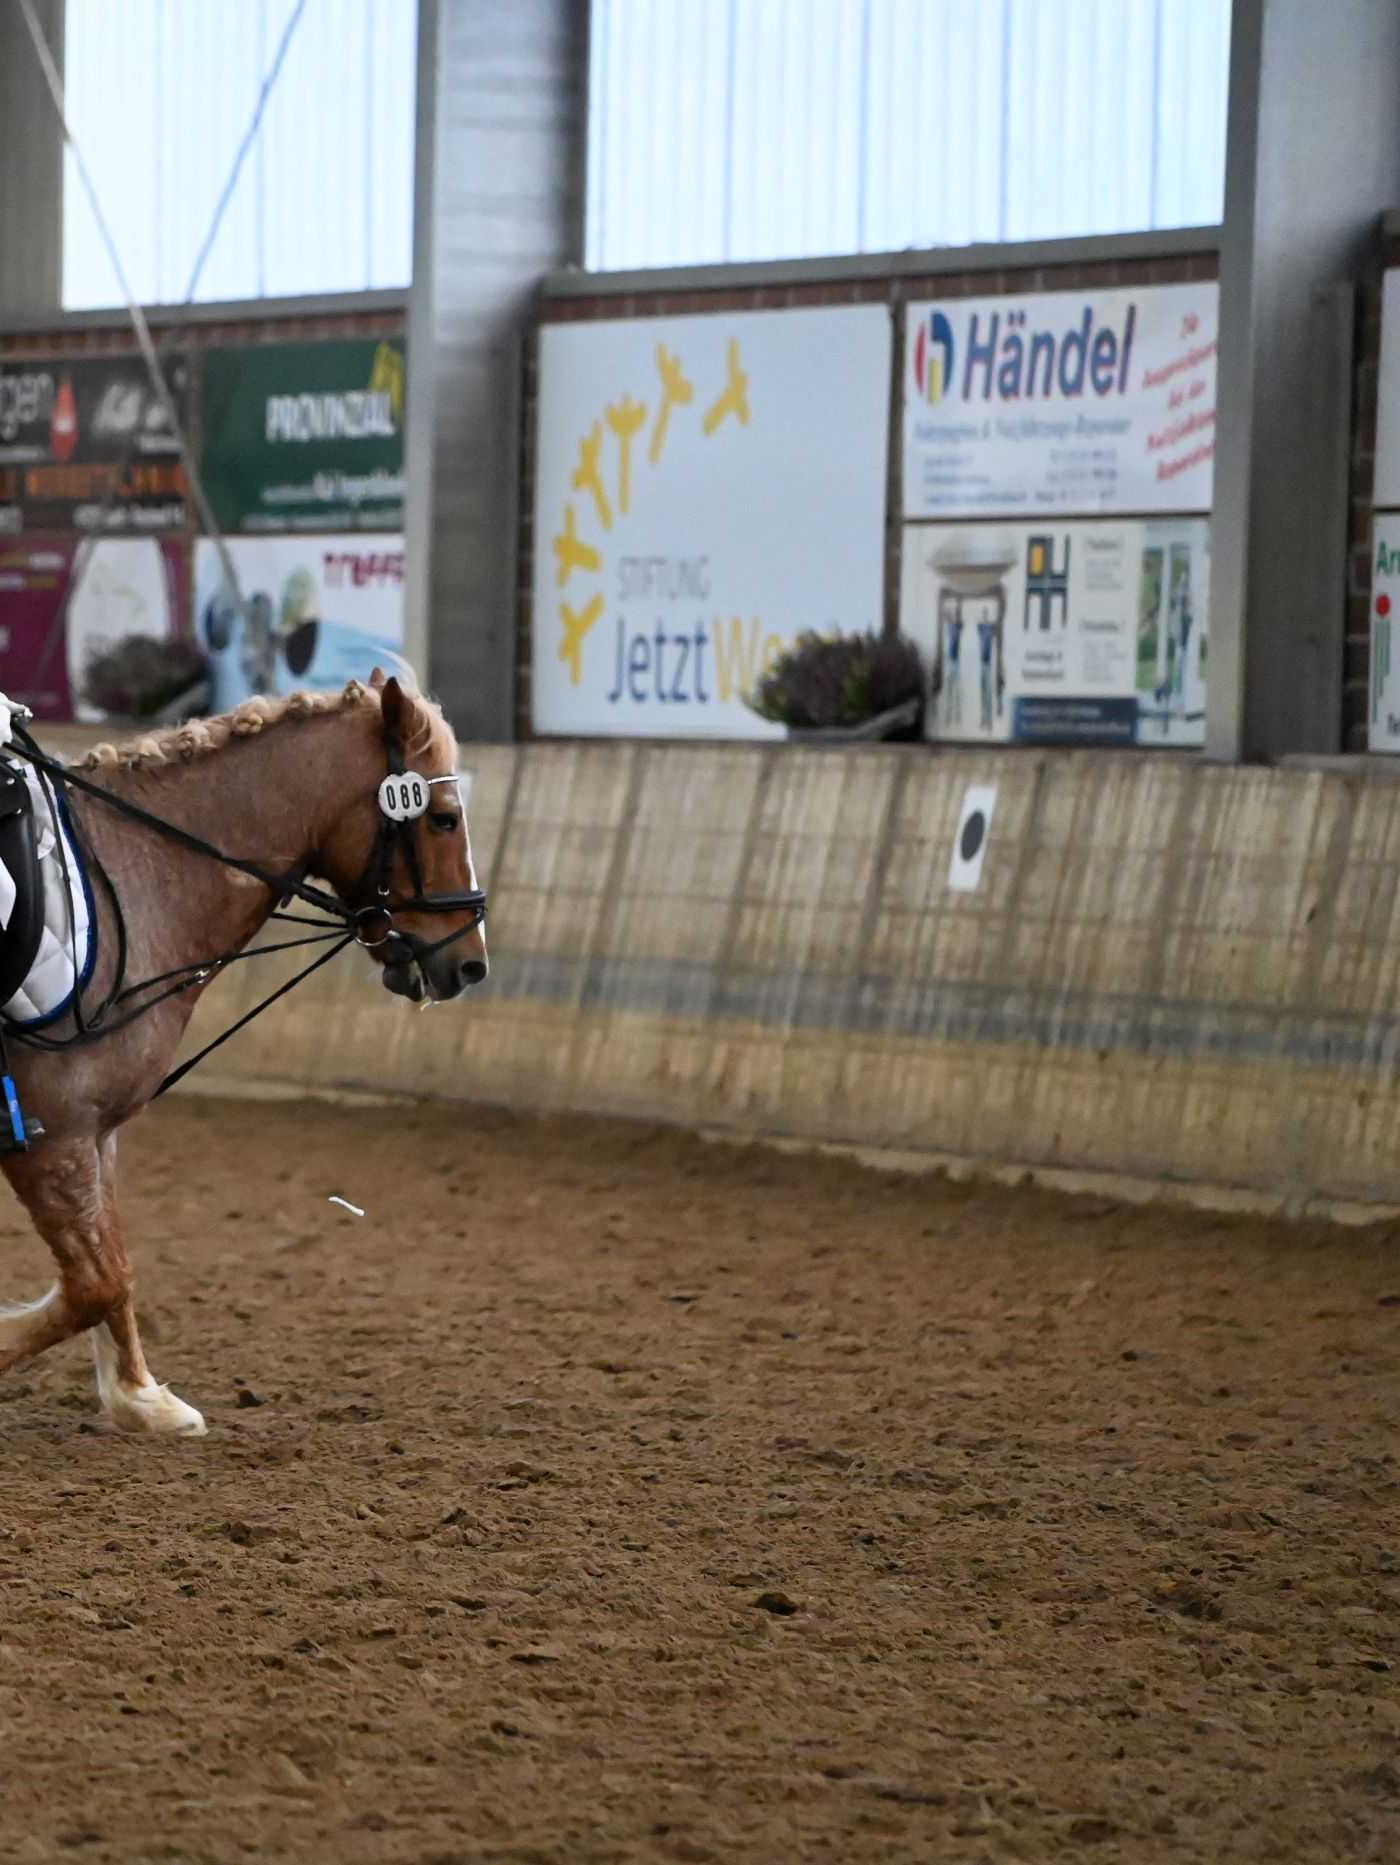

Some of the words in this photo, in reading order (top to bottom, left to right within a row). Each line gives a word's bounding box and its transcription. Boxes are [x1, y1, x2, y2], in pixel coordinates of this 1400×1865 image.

[962, 303, 1138, 403] Händel
[265, 390, 396, 442] PROVINZIAL
[385, 782, 423, 811] 088
